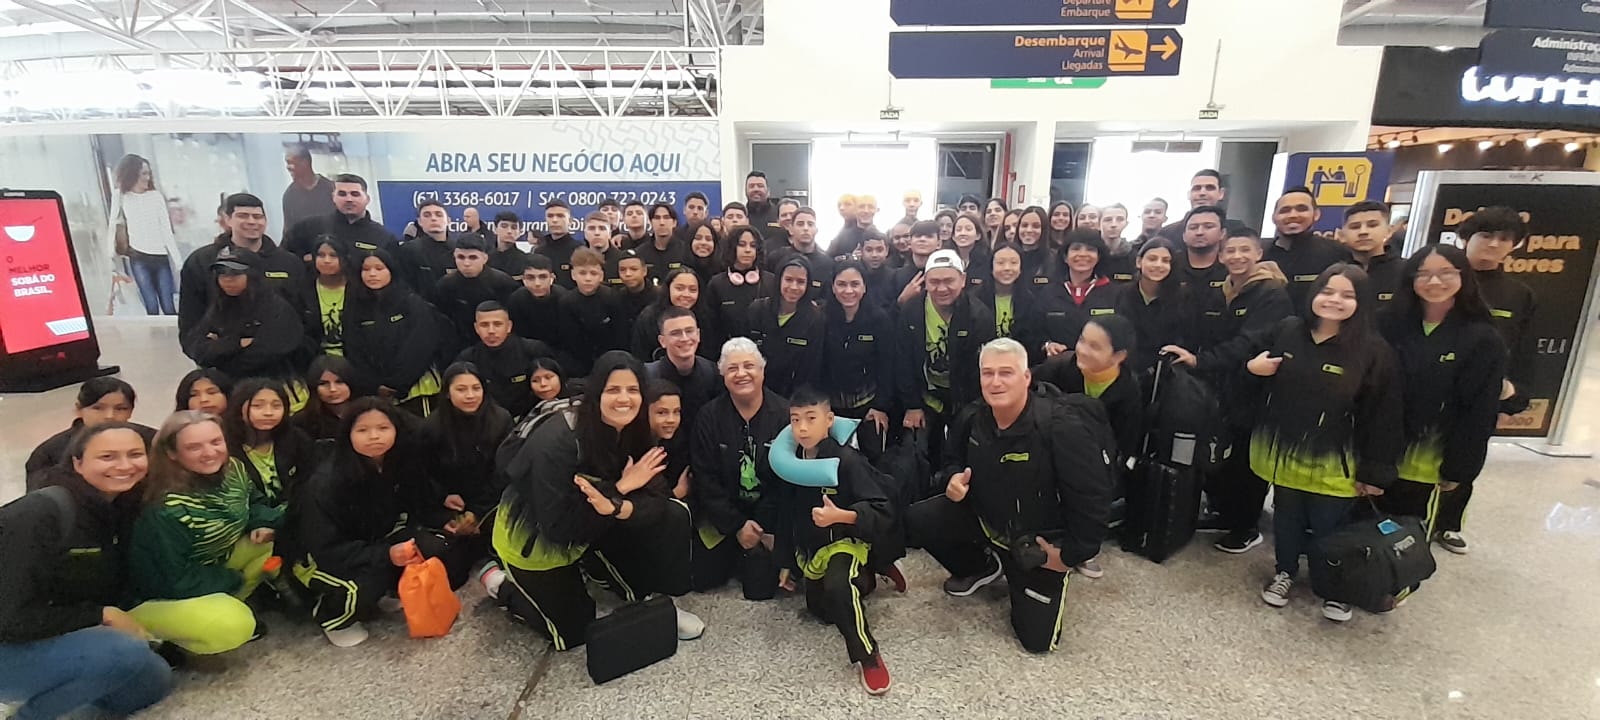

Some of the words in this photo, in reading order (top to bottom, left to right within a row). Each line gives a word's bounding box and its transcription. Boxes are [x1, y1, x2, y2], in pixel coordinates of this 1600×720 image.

[1060, 7, 1111, 19] Embarque
[1014, 34, 1106, 48] Desembarque
[1073, 48, 1105, 58] Arrival
[1061, 60, 1103, 72] Llegadas
[425, 152, 482, 173] ABRA
[487, 152, 526, 173] SEU
[532, 148, 625, 173] NEGÓCIO
[629, 152, 681, 177] AQUI
[412, 190, 439, 208] (67)
[443, 191, 520, 206] 3368-6017
[538, 191, 565, 206] SAC
[568, 191, 607, 206] 0800
[640, 191, 676, 206] 0243
[1527, 234, 1581, 253] para
[40, 273, 56, 283] DO
